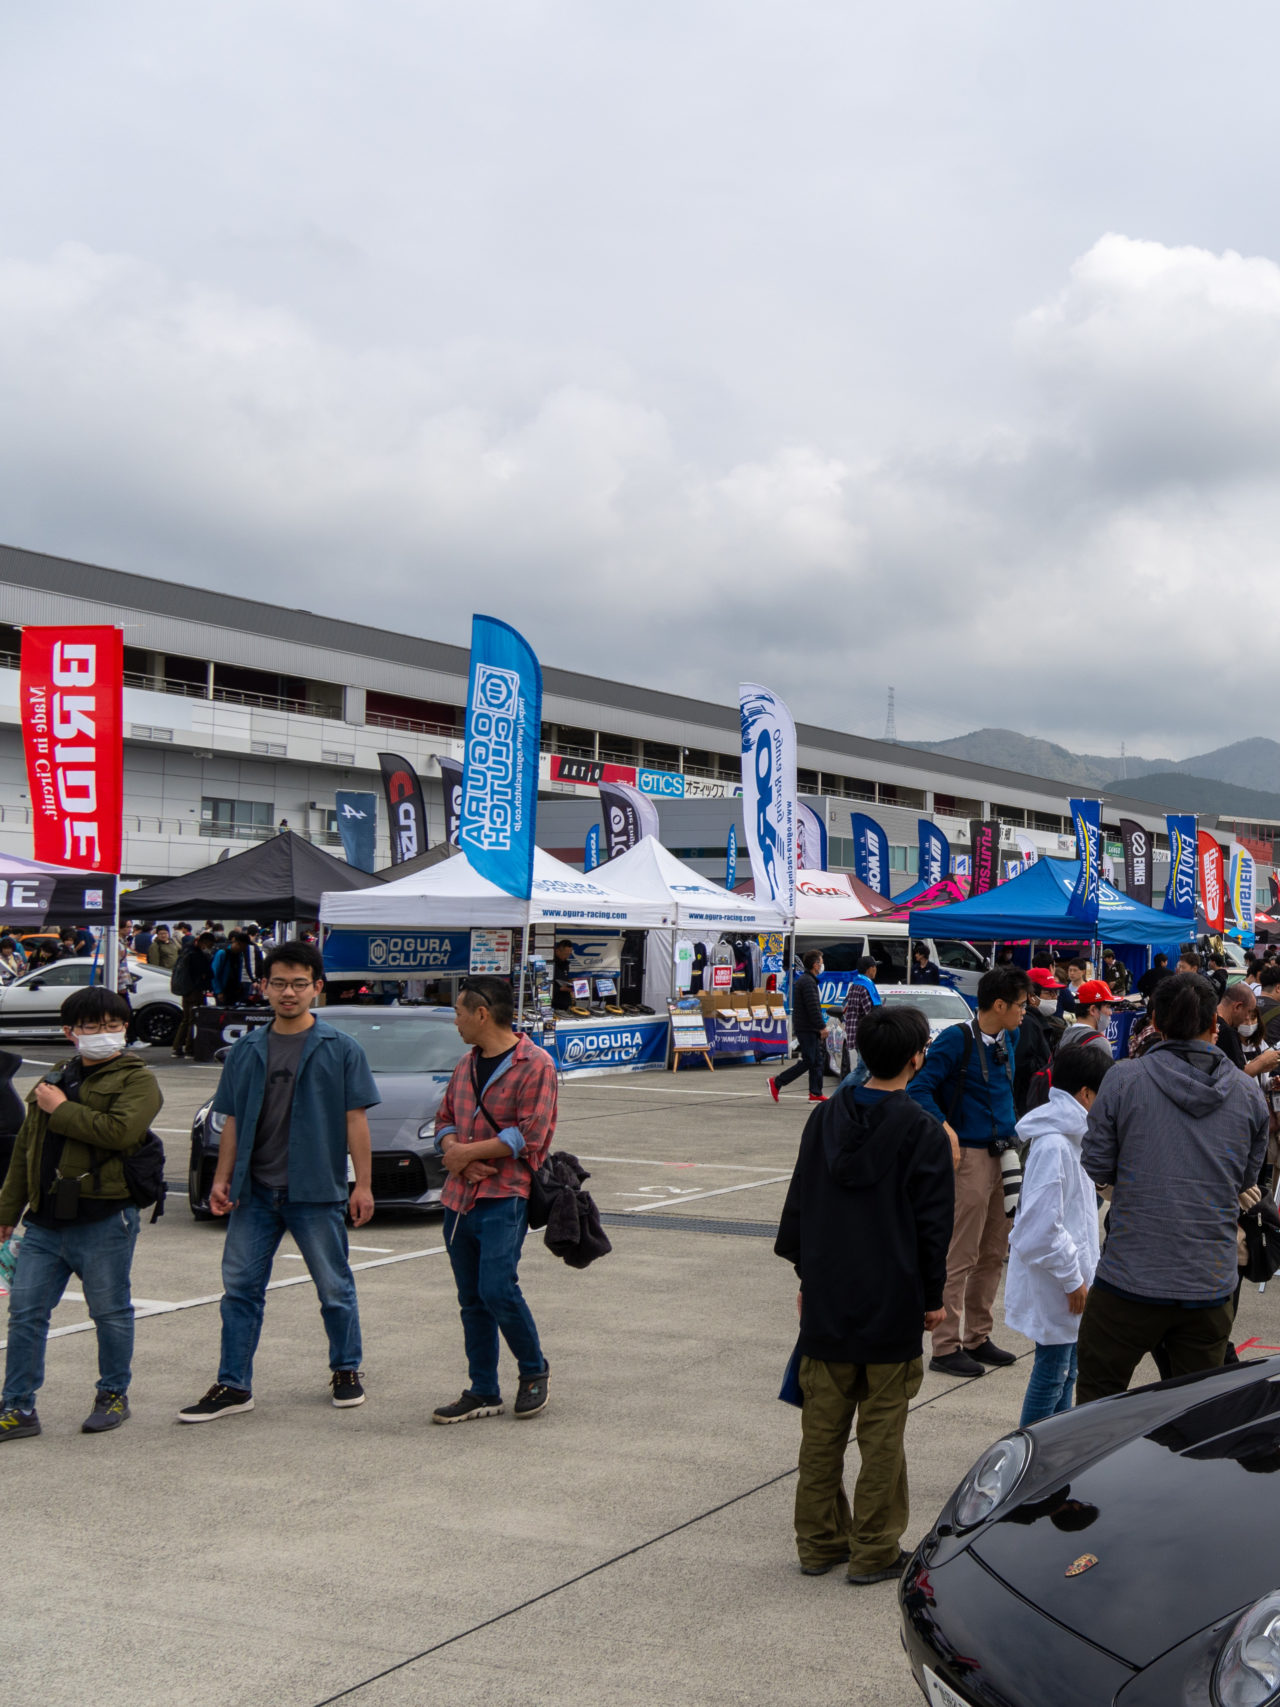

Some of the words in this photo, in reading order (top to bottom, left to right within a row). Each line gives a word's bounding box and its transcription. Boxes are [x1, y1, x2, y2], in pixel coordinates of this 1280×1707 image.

[640, 772, 683, 795] OTICS
[685, 781, 726, 798] オティックス
[1177, 833, 1195, 904] ENDLESS
[542, 908, 627, 920] www.ogura-racing.com
[688, 912, 756, 922] www.ogura-racing.com
[389, 938, 452, 951] OGURA
[388, 952, 451, 966] CLUTCH
[586, 1031, 643, 1050] OGURA
[581, 1046, 642, 1062] CLUTCH
